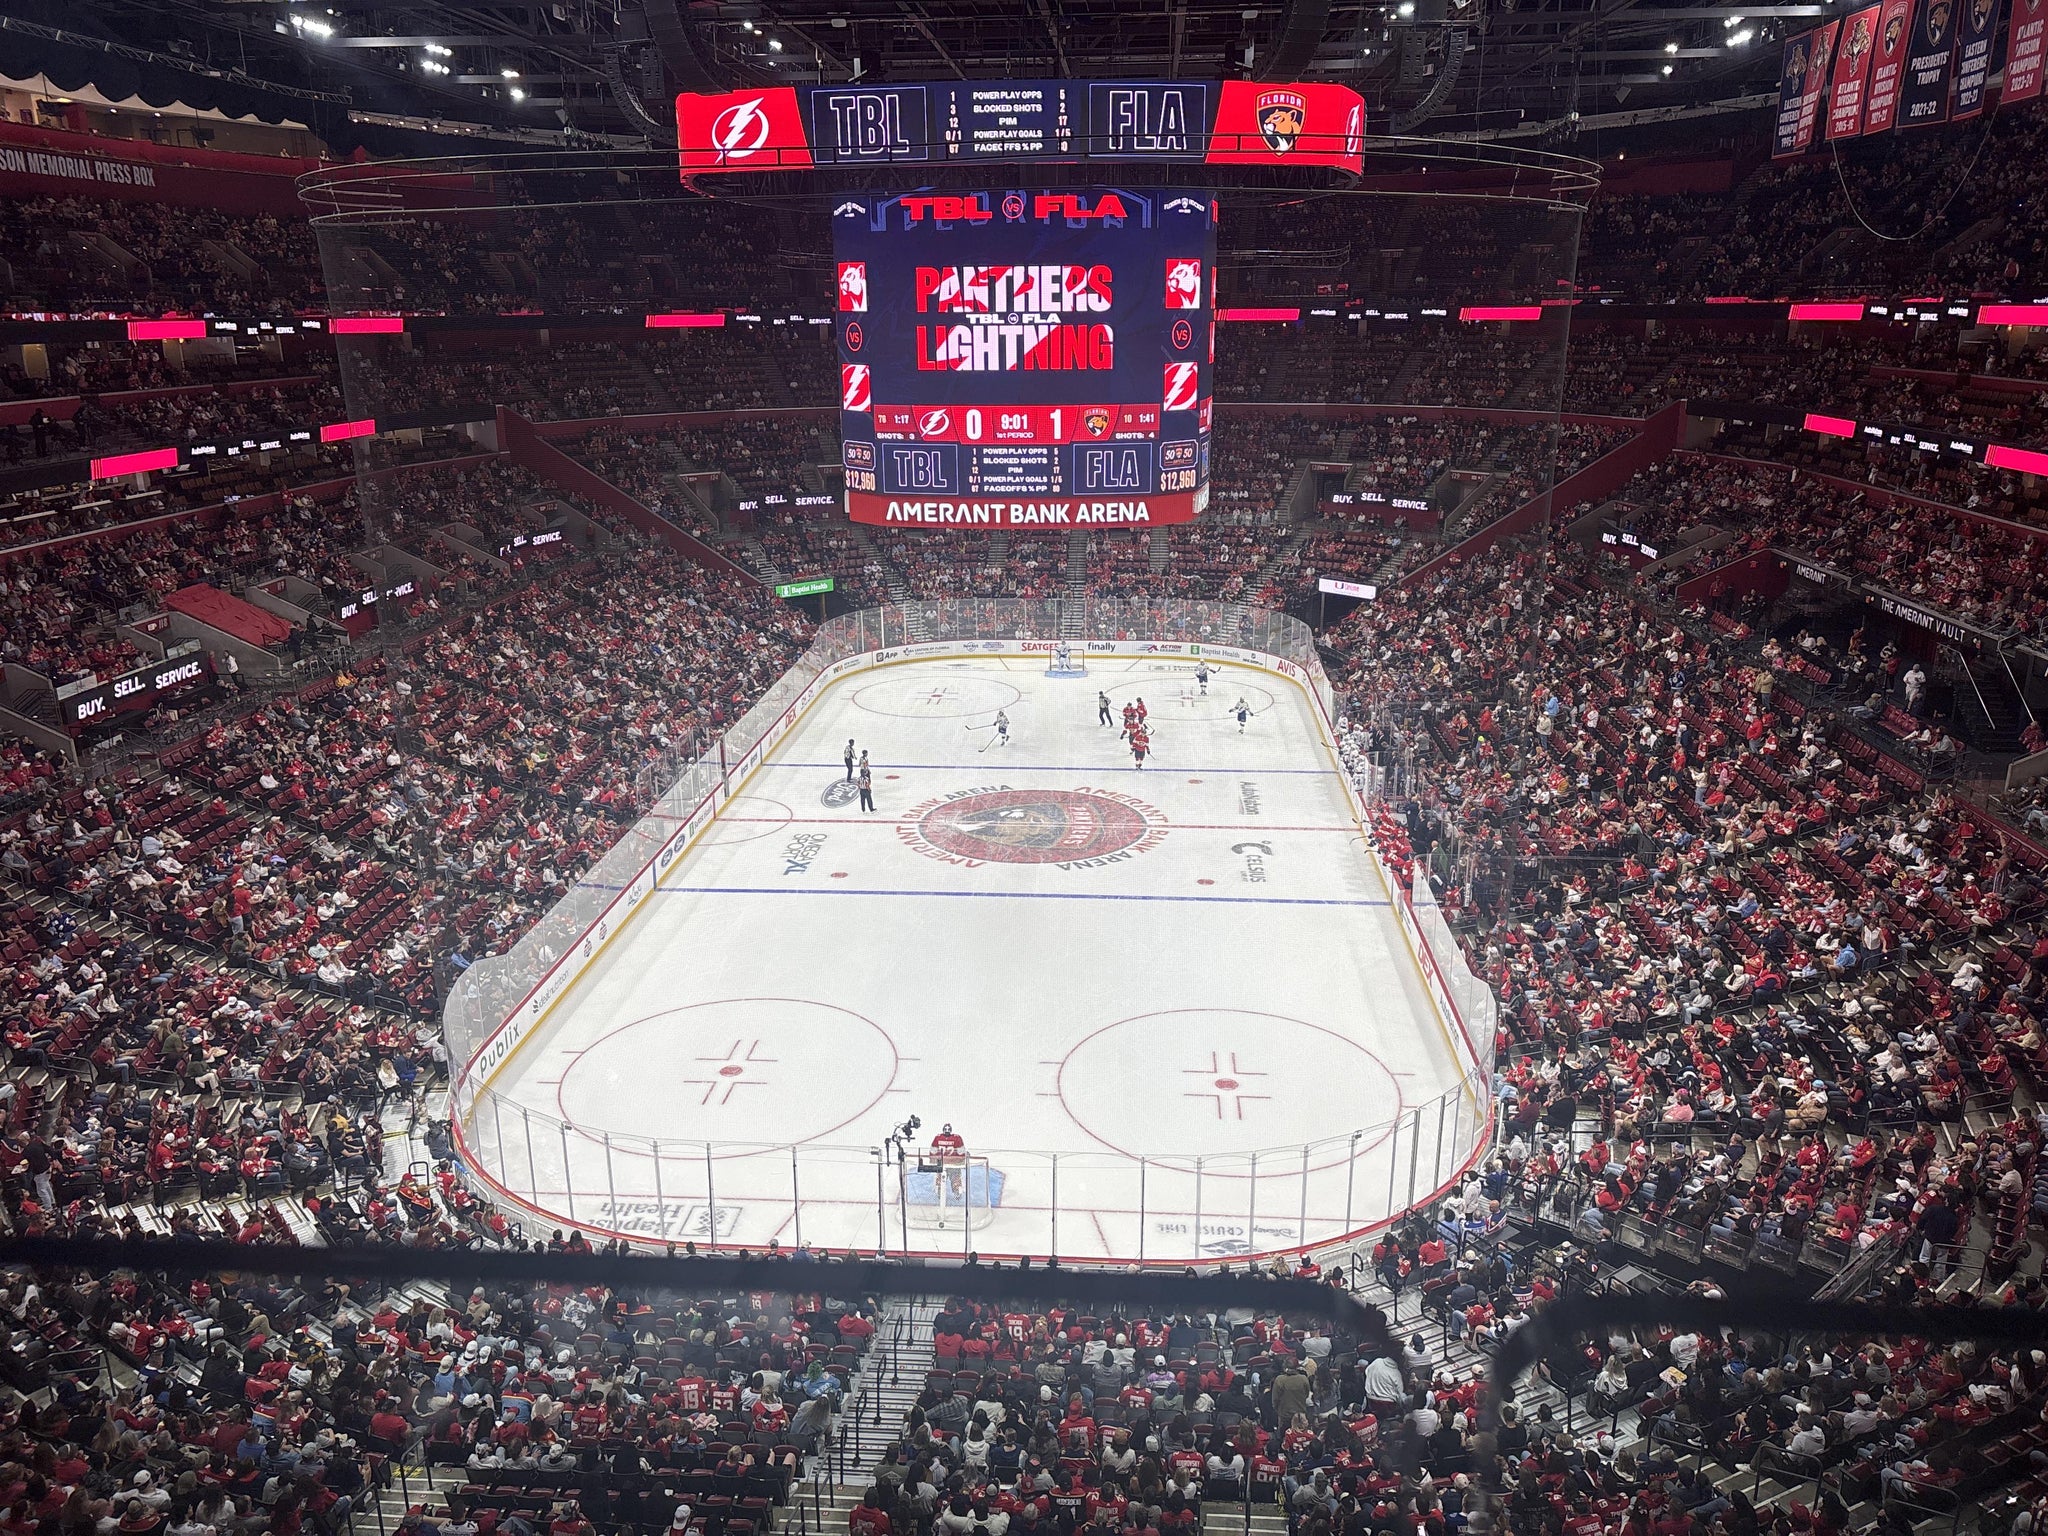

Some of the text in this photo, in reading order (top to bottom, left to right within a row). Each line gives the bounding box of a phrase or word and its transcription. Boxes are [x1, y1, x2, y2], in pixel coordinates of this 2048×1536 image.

[1917, 69, 1941, 85] TROPHY
[950, 89, 1065, 101] 1 POWER PLAY OPPS 5
[1261, 94, 1301, 107] FLORIDA
[950, 103, 1065, 115] 3 BLOCKED SHOTS 2
[1910, 101, 1937, 116] 2021-22
[830, 96, 909, 154] TBL
[949, 116, 1068, 128] 12 PIM 17
[1109, 90, 1187, 150] FLA
[1030, 142, 1042, 150] PP
[27, 152, 94, 180] MEMORIAL
[95, 160, 132, 184] PRESS
[132, 165, 156, 187] BOX
[901, 197, 992, 219] TBL
[1007, 202, 1019, 213] VS
[1035, 195, 1128, 218] FLA
[916, 265, 1112, 312] PANTHERS
[966, 313, 1061, 324] TBL FLA
[850, 332, 859, 342] VS
[1176, 329, 1187, 340] VS
[917, 325, 1113, 371] LIGHTNING
[894, 415, 909, 424] 1:17
[966, 409, 982, 440] 0
[1001, 414, 1028, 430] 9:01
[1050, 409, 1061, 439] 1
[1124, 414, 1154, 423] 10 1:41
[848, 449, 870, 460] 50 50
[1165, 448, 1192, 459] 50 50
[894, 450, 947, 488] TBL
[1086, 450, 1139, 488] FLA
[846, 470, 876, 491] $12,960
[1160, 470, 1196, 491] $12,960
[739, 495, 834, 510] BUY. SELL. SERVICE.
[1332, 493, 1428, 511] BUY. SELL. SERVICE.
[886, 501, 1150, 524] AMERANT BANK ARENA
[532, 531, 562, 545] SERVICE.
[1602, 532, 1616, 545] BUY.
[1796, 564, 1826, 584] AMERANT
[792, 583, 828, 594] Baptist Health
[341, 603, 358, 618] BUY.
[1881, 598, 1966, 643] THE AMERANT VAULT
[1088, 642, 1115, 653] finally
[1201, 647, 1240, 658] Baptist Health
[1276, 660, 1296, 677] AVIS
[78, 662, 202, 719] BUY. SELL. SERVICE.
[945, 784, 1014, 800] ARENA
[902, 798, 938, 820] BANK
[1057, 787, 1169, 871] AMERANT BANK ARENA
[801, 834, 827, 861] OMEGA
[896, 826, 987, 868] AMERANT
[1246, 854, 1266, 882] CELSIUS
[1418, 942, 1434, 988] DEX
[600, 1202, 683, 1218] Health
[1009, 1326, 1023, 1337] 19
[684, 1390, 698, 1408] 19
